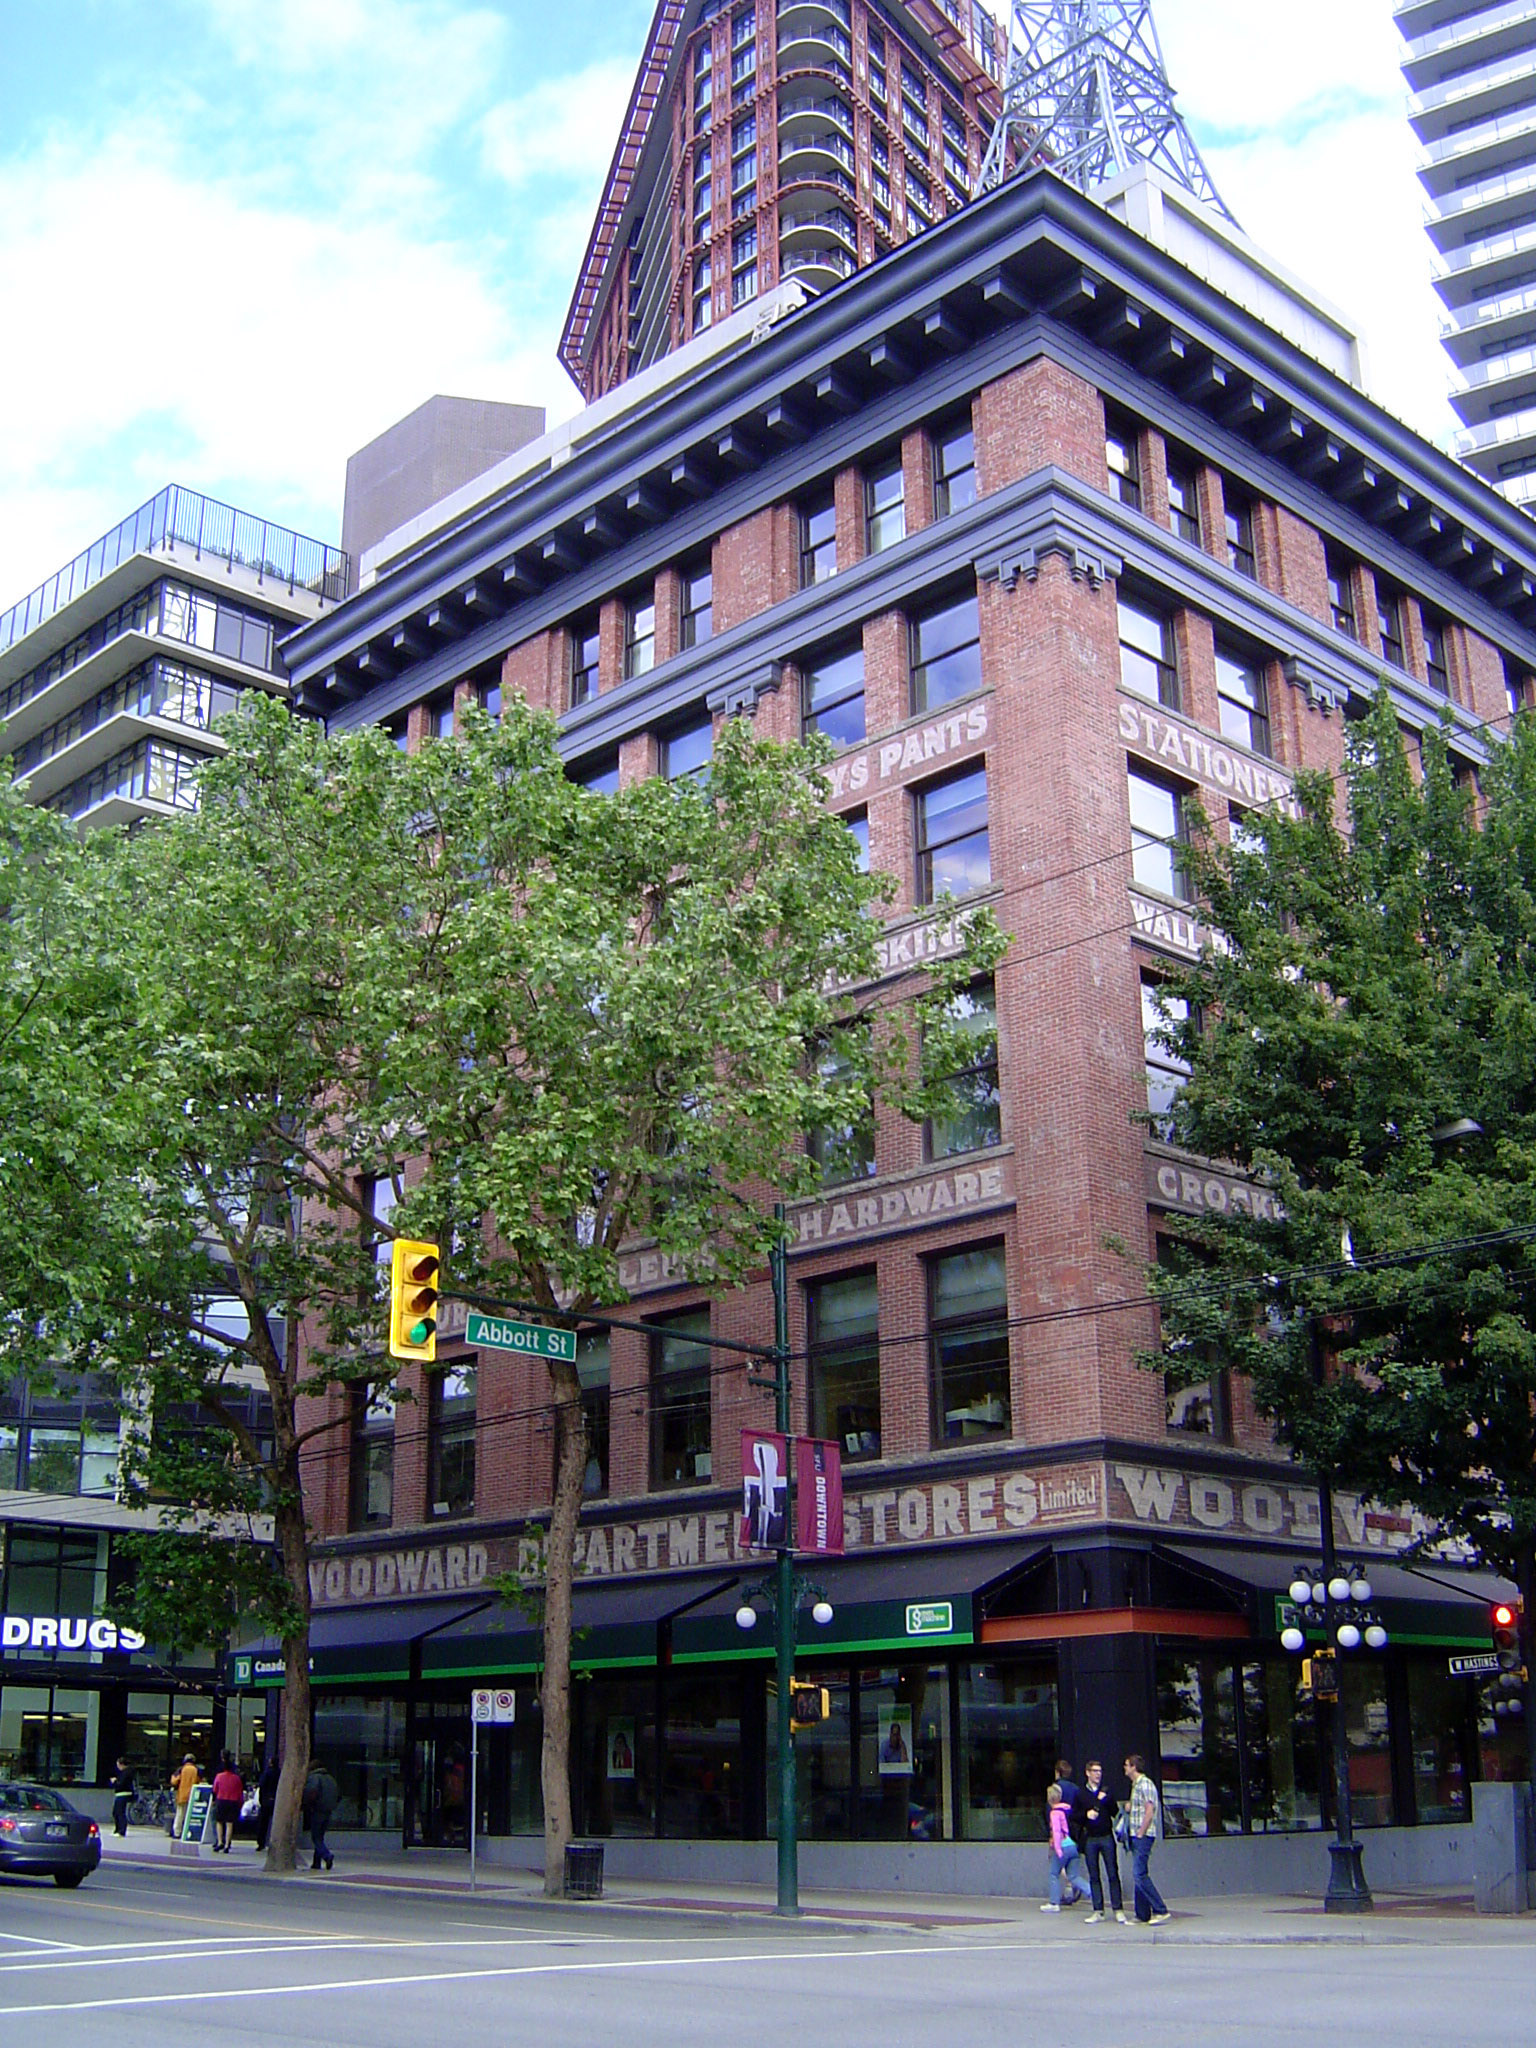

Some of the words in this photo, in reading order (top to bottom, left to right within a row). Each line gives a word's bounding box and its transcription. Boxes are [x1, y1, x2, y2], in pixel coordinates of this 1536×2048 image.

[880, 704, 988, 778] PANTS
[1130, 898, 1203, 952] WALL
[800, 1167, 1004, 1241] HARDWARE
[476, 1320, 540, 1350] Abbott
[547, 1333, 567, 1354] St
[816, 1476, 827, 1548] DOWNTOWN
[1040, 1474, 1096, 1510] Limited
[2, 1616, 146, 1650] DRUGS
[1464, 1656, 1499, 1670] HASTINGS
